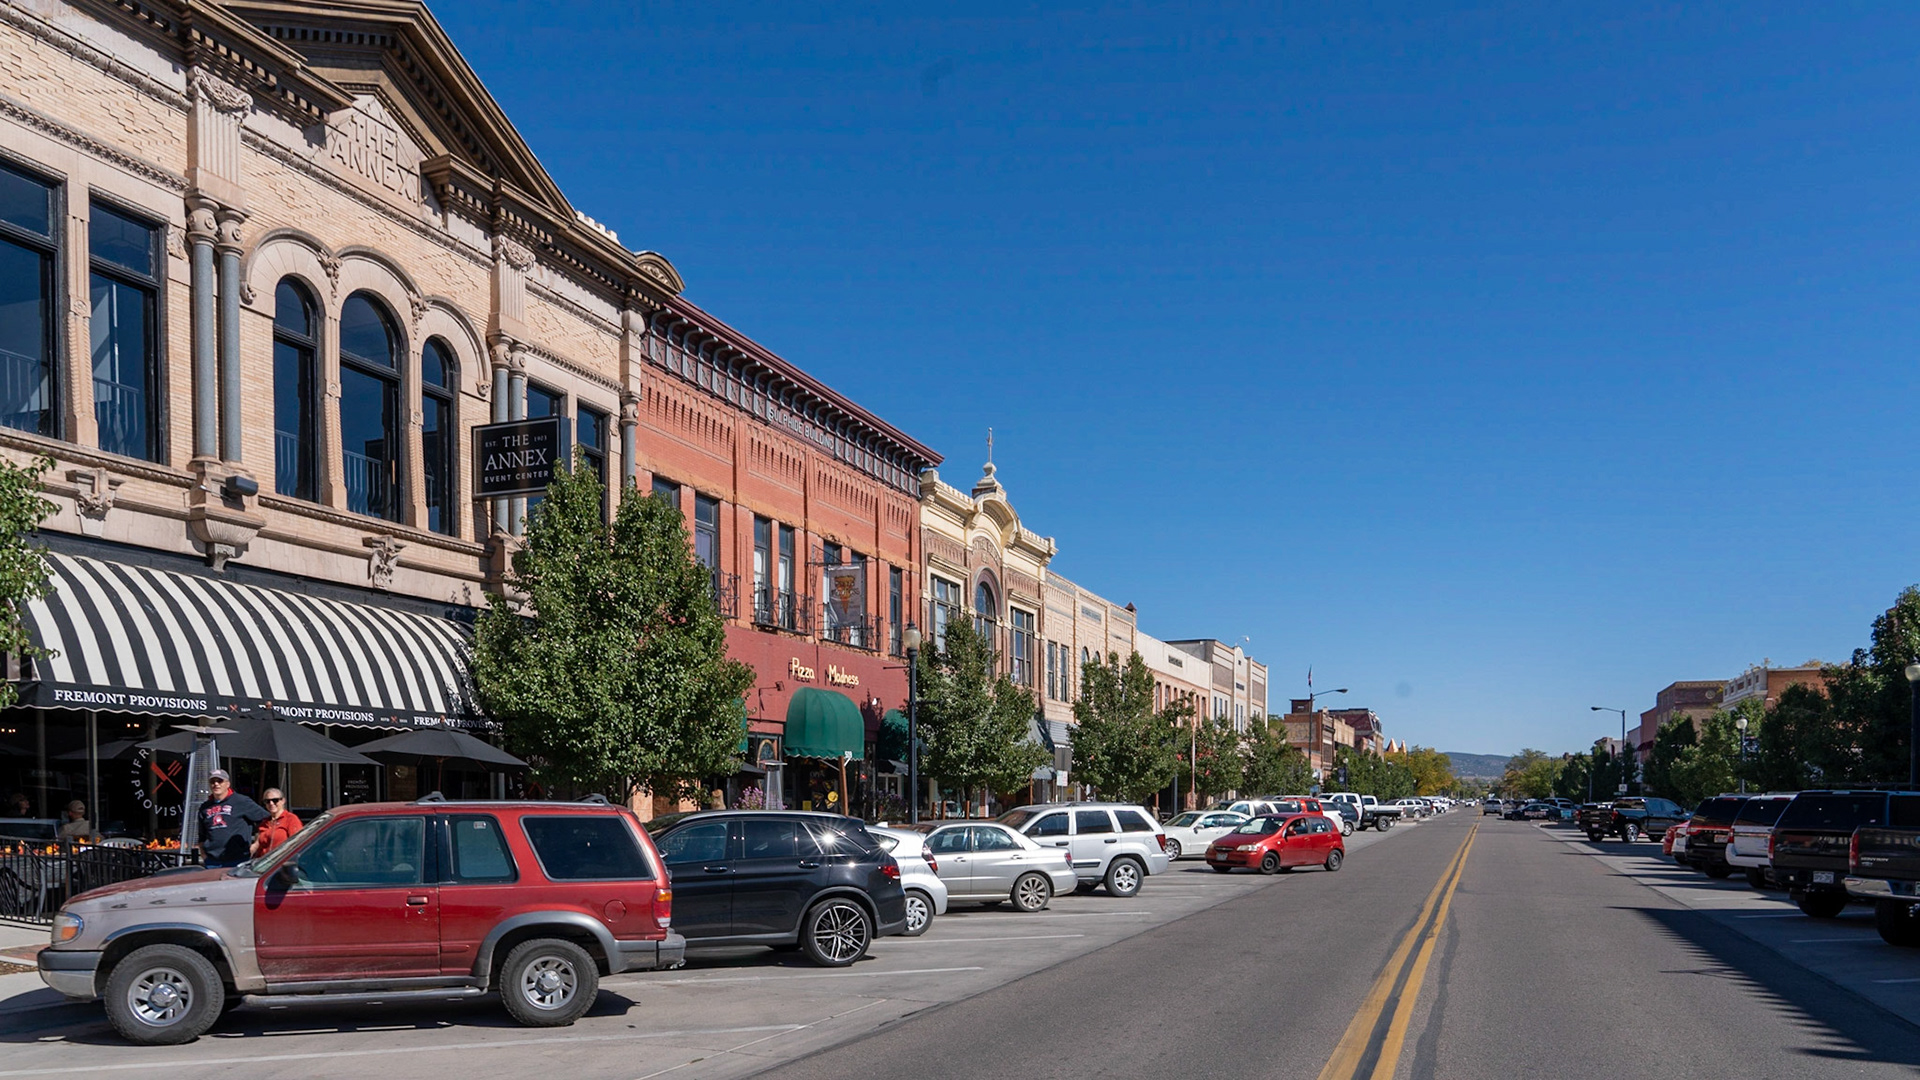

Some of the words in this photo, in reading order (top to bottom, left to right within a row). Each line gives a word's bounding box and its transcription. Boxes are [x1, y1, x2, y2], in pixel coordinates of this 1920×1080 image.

[348, 118, 395, 162] THE
[768, 406, 804, 435] SULPHIDE
[804, 425, 834, 450] BUILDING
[502, 433, 530, 448] THE
[485, 448, 548, 471] ANNEX
[484, 474, 511, 483] EVENT
[515, 470, 549, 480] CENTER
[792, 657, 816, 680] Pizza
[828, 664, 860, 686] Madness
[54, 689, 126, 705] FREMONT
[129, 694, 208, 711] PROVISIONS
[258, 704, 313, 719] MONT
[315, 708, 375, 722] PROVISIONS
